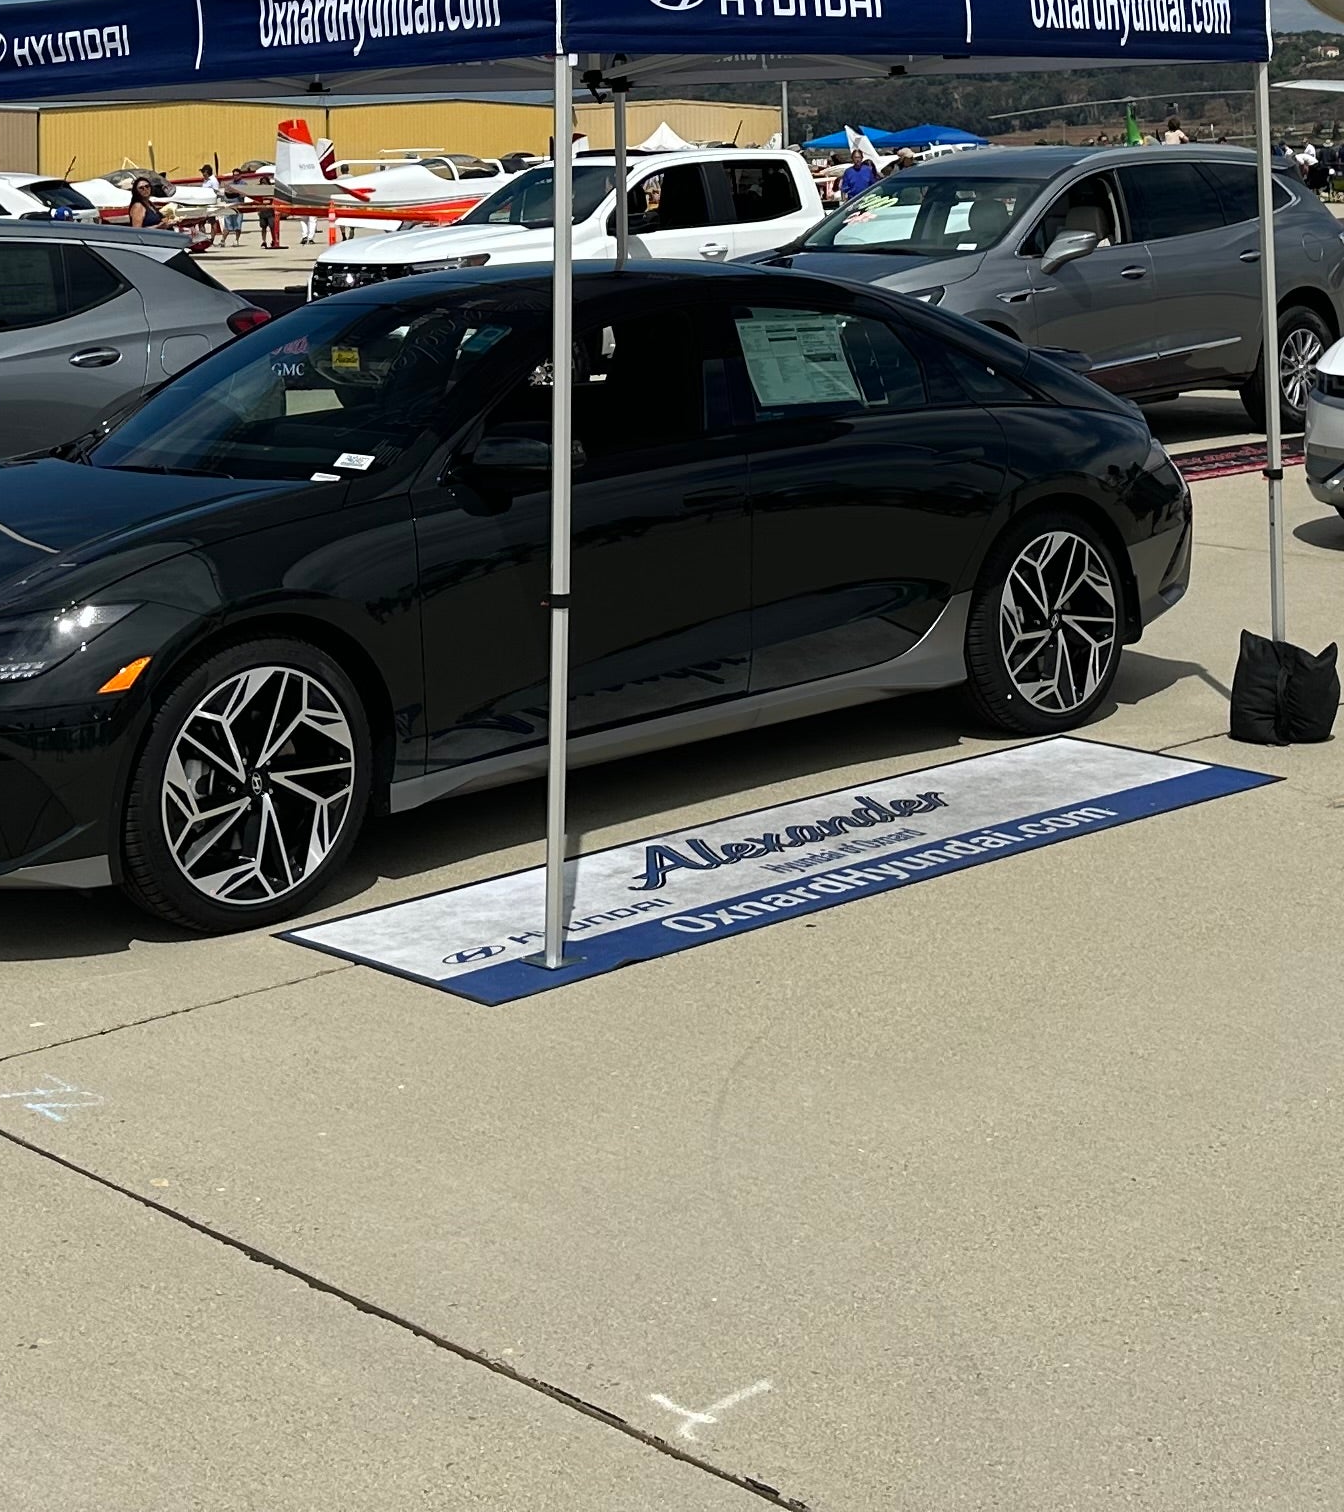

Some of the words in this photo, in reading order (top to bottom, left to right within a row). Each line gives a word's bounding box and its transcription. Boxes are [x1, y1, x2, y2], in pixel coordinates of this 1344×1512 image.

[13, 23, 131, 67] HYUNDAI
[628, 790, 952, 891] Alexander
[759, 847, 848, 874] Hyundai
[854, 827, 928, 849] Oxnard
[660, 803, 1119, 934] OxnardHyundai.com
[507, 897, 675, 945] HUNDAI
